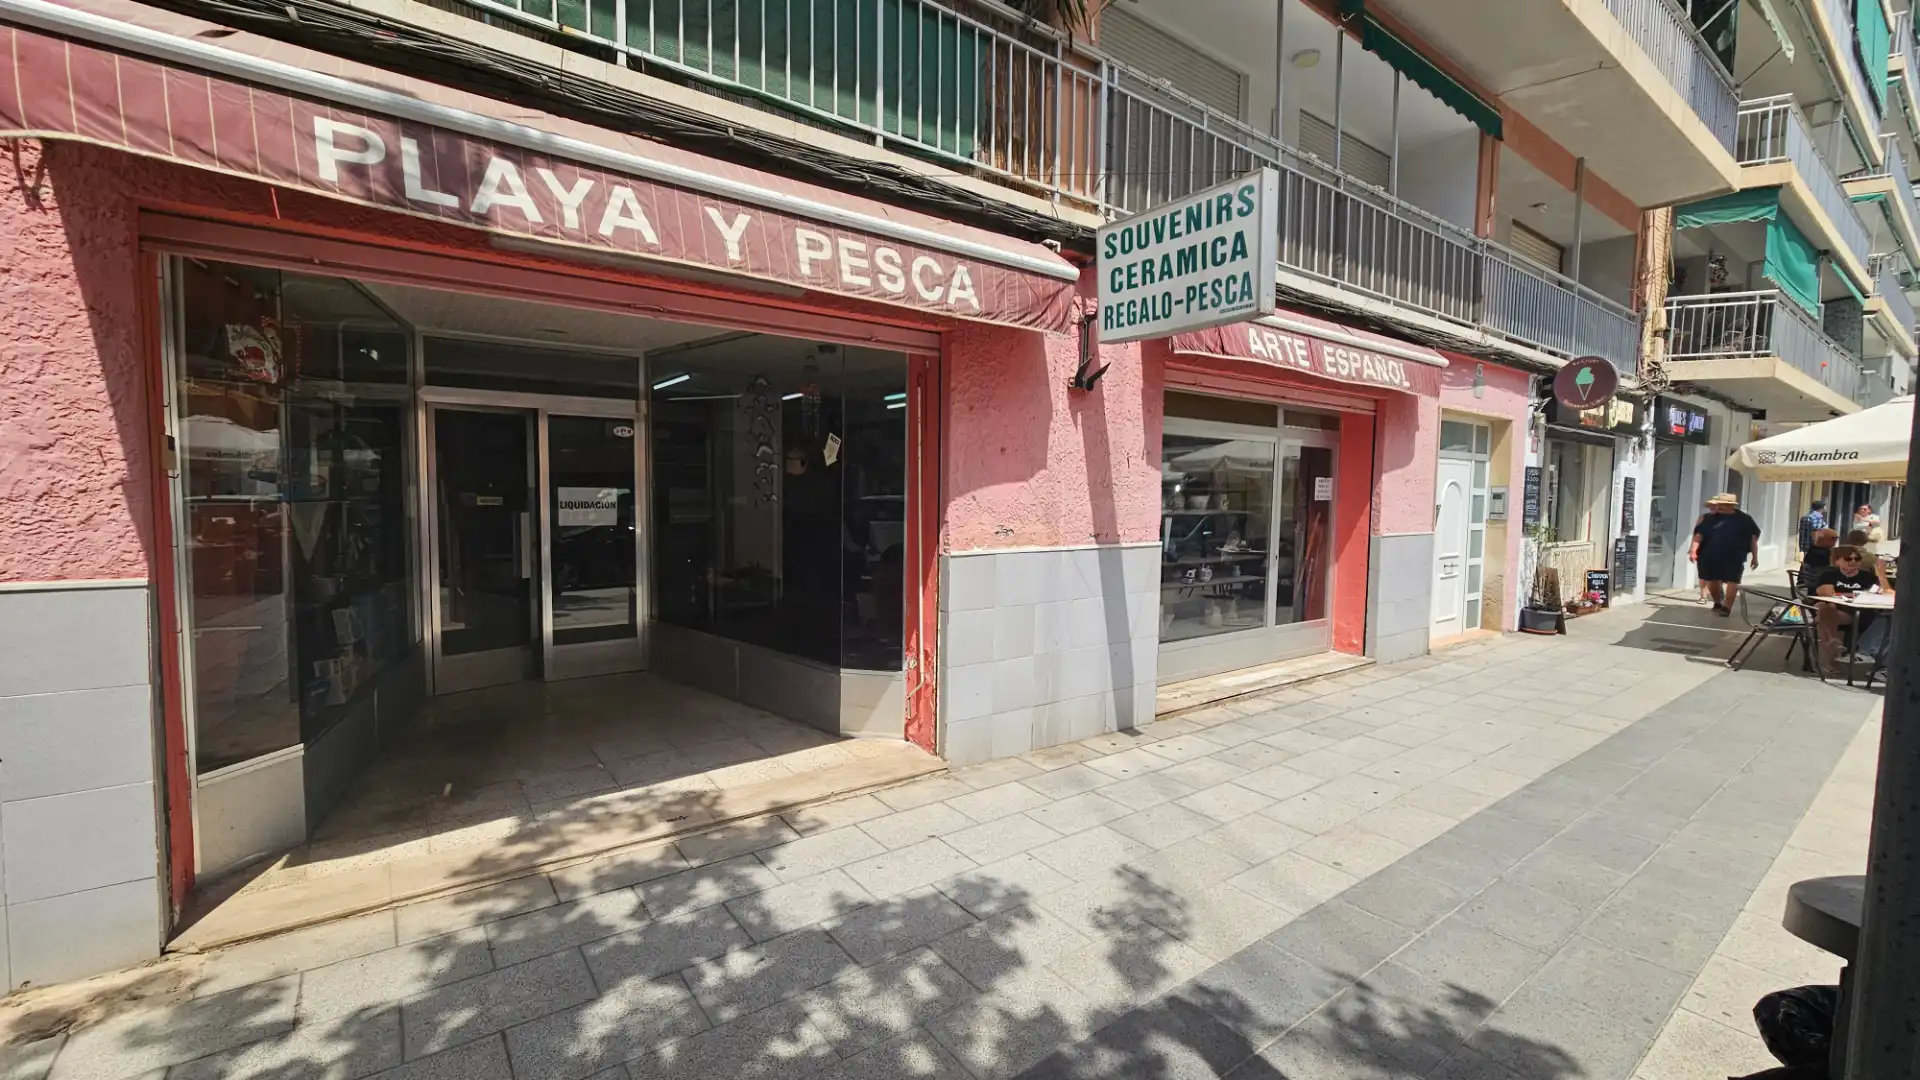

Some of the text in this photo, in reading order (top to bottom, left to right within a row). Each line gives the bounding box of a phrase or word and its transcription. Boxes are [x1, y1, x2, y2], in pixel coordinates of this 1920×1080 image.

[314, 116, 980, 310] PLAYA Y PESCA
[1104, 184, 1255, 260] SOUVENIRS
[1110, 230, 1248, 294] CERAMICA
[1104, 271, 1253, 331] REGALO-PESCA
[1248, 327, 1410, 387] ARTE ESPAÑOL
[1781, 448, 1859, 463] Alhambra
